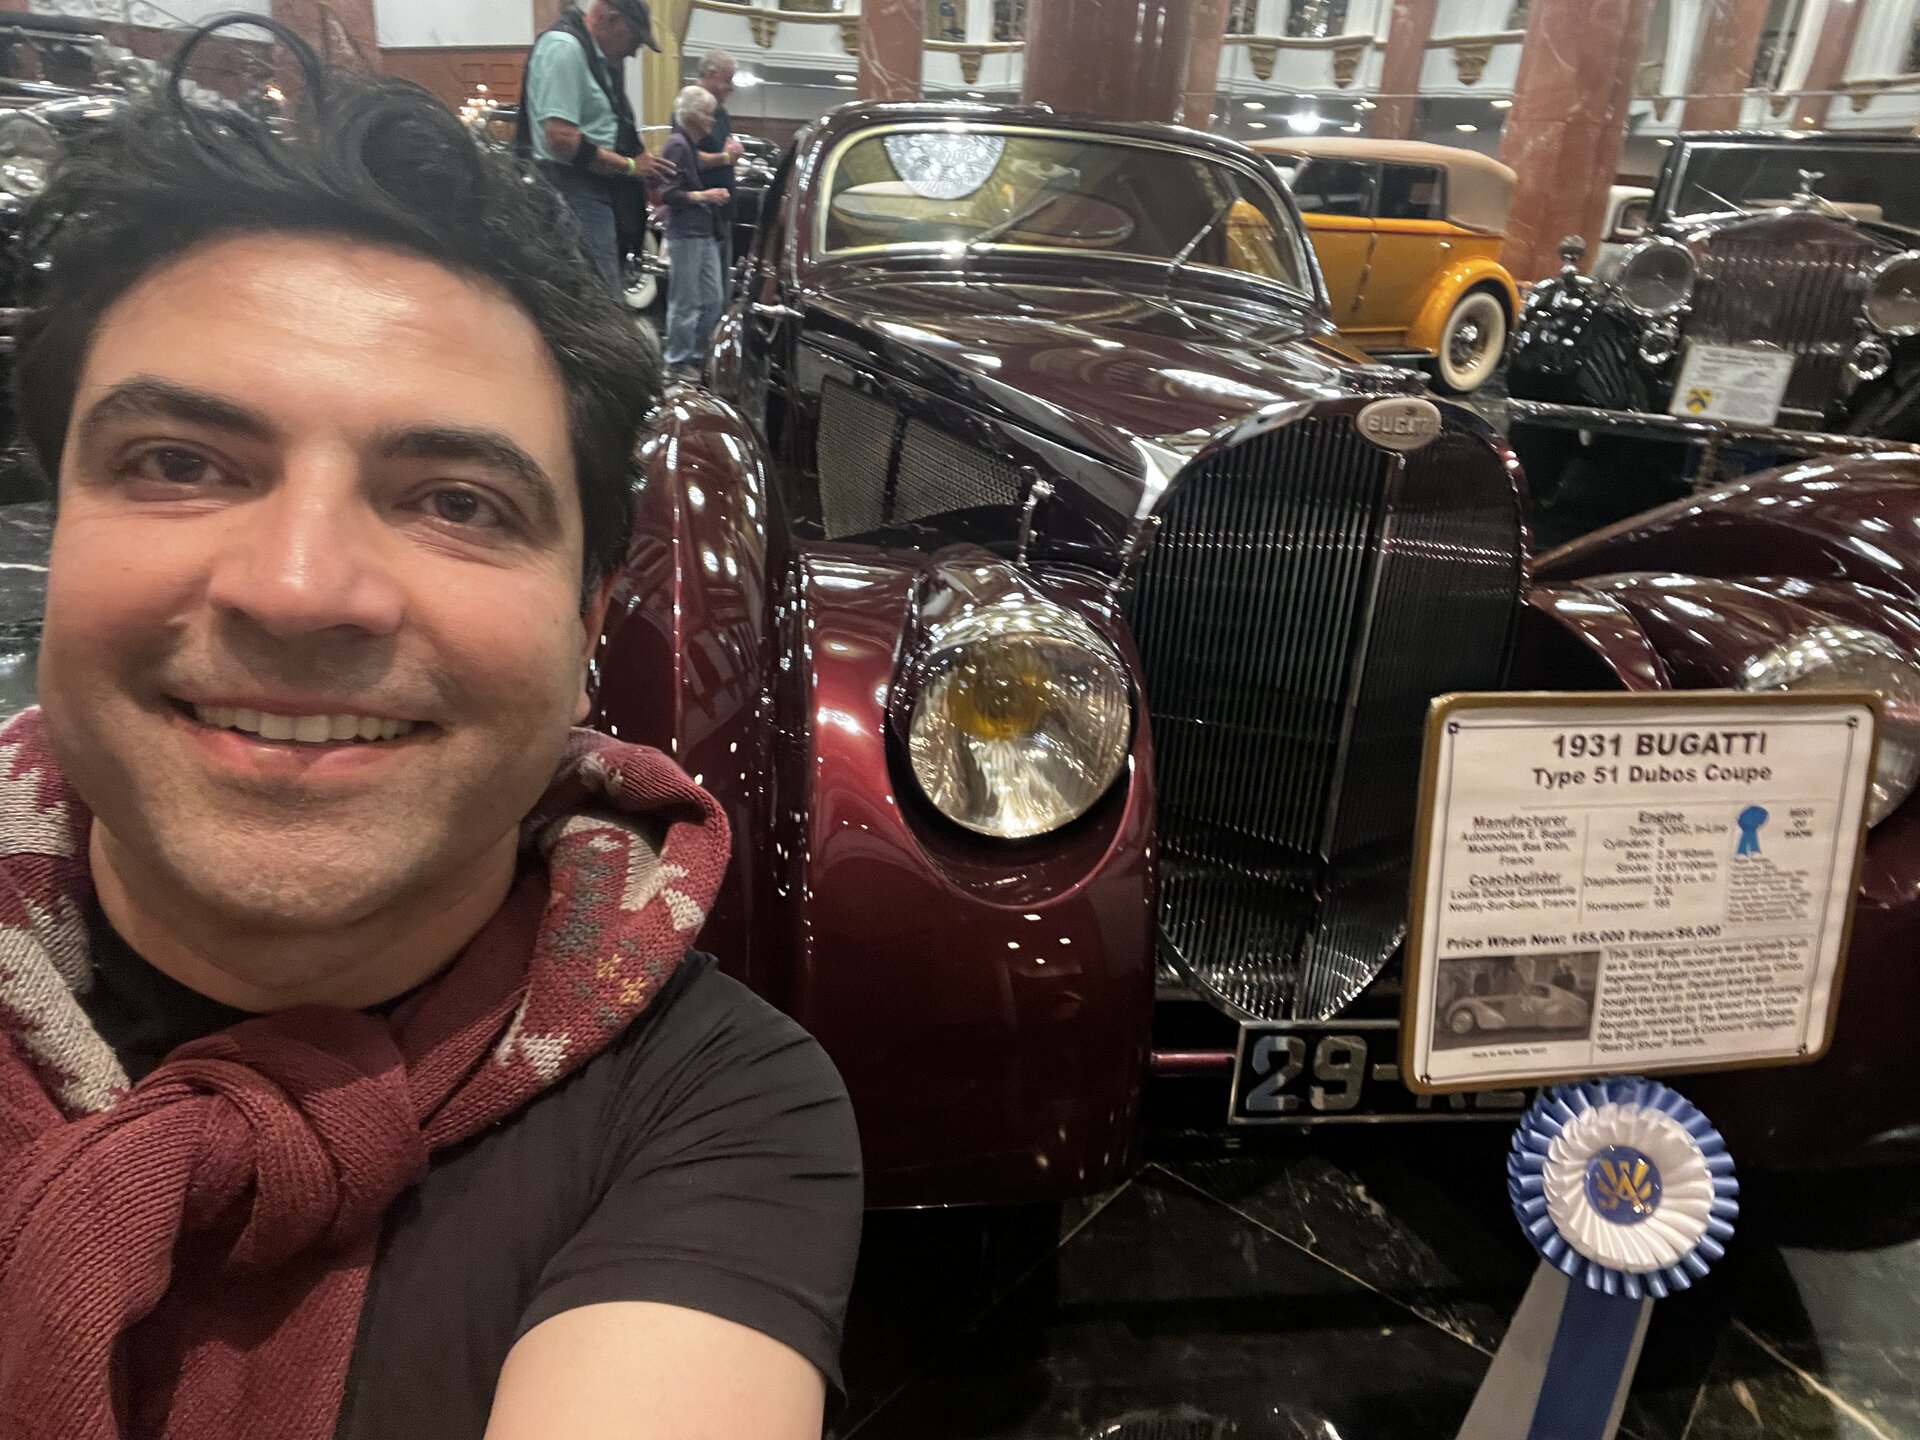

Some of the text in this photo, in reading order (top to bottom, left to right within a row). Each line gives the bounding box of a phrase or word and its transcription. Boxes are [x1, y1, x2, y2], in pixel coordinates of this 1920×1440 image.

[1553, 732, 1768, 758] 1931 BUGATTI
[1532, 763, 1773, 789] Type 51 Dubos Coupe
[1472, 815, 1568, 829] Manufacturer
[1469, 872, 1561, 886] Coachbuilder
[1446, 936, 1483, 950] Price
[1487, 935, 1527, 948] When
[1530, 933, 1567, 946] New:
